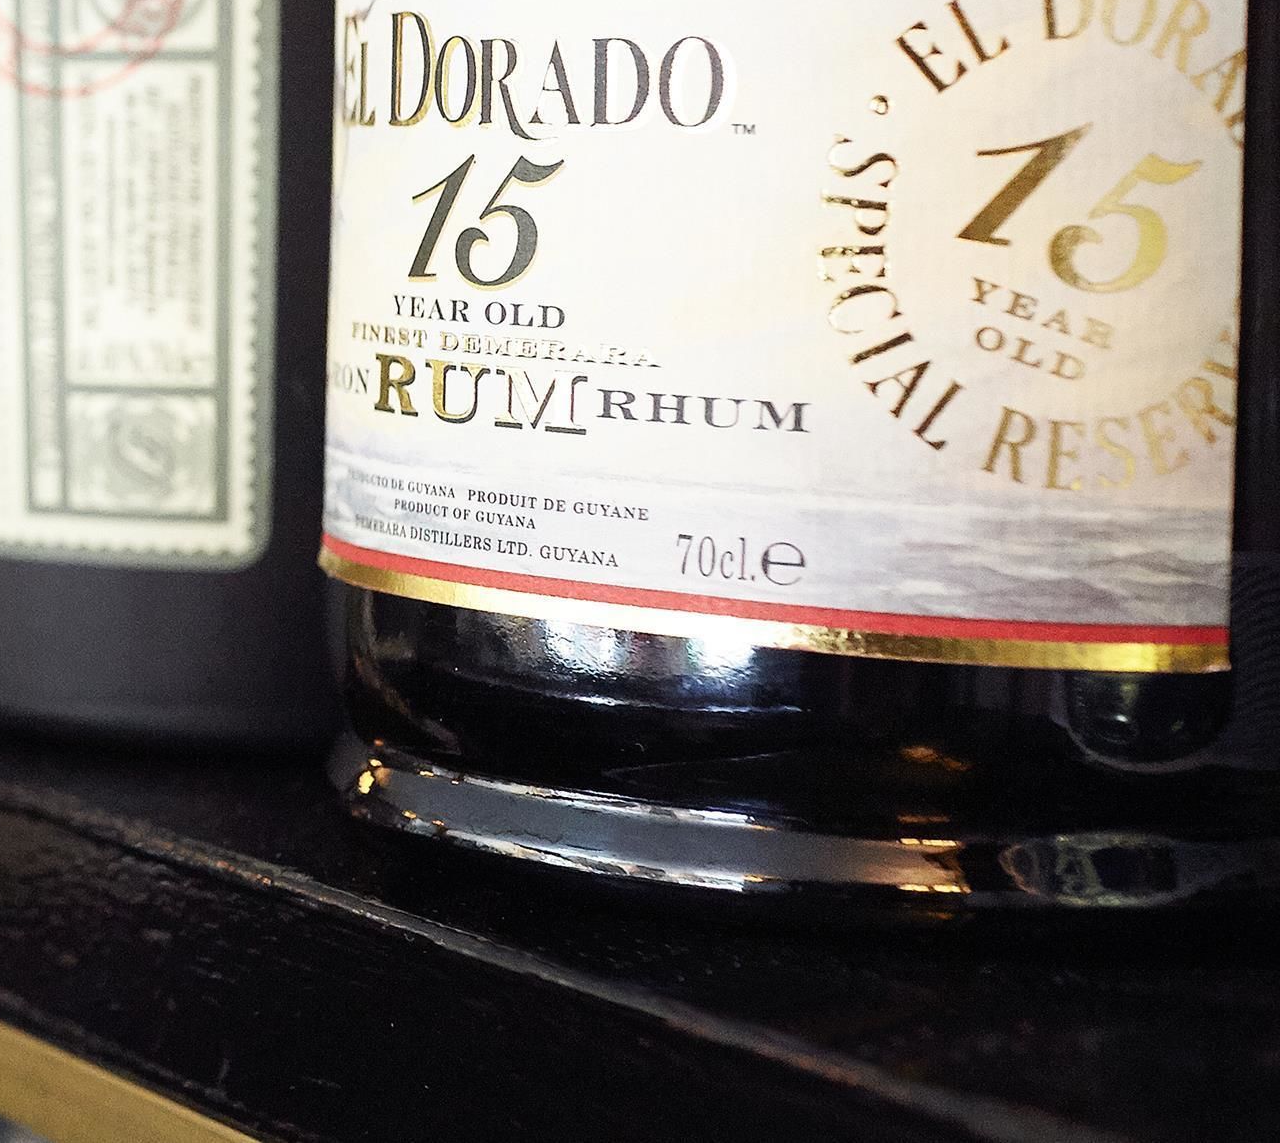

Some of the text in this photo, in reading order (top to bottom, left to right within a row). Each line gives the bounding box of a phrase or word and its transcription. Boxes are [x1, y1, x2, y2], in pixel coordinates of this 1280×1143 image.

[342, 15, 376, 127] EL
[389, 11, 726, 141] DORADO
[407, 154, 565, 291] 15
[957, 122, 1204, 295] 15
[393, 295, 566, 329] YEAR OLD
[819, 132, 964, 452] SPECIAL
[969, 276, 1117, 350] YEAR
[352, 321, 662, 368] FINEST DEMERARA
[975, 326, 1087, 381] OLD
[374, 352, 588, 436] RUM
[596, 388, 812, 433] RHUM
[391, 478, 404, 491] DE
[407, 481, 456, 499] GUYANA
[468, 489, 538, 509] PRODUIT
[543, 498, 566, 513] DE
[573, 502, 650, 521] GUYANE
[394, 498, 537, 530] PRODUCT OF GUYANA
[410, 526, 492, 552] DISTILLERS
[497, 539, 533, 557] LTD.
[539, 545, 619, 568] GUYANA
